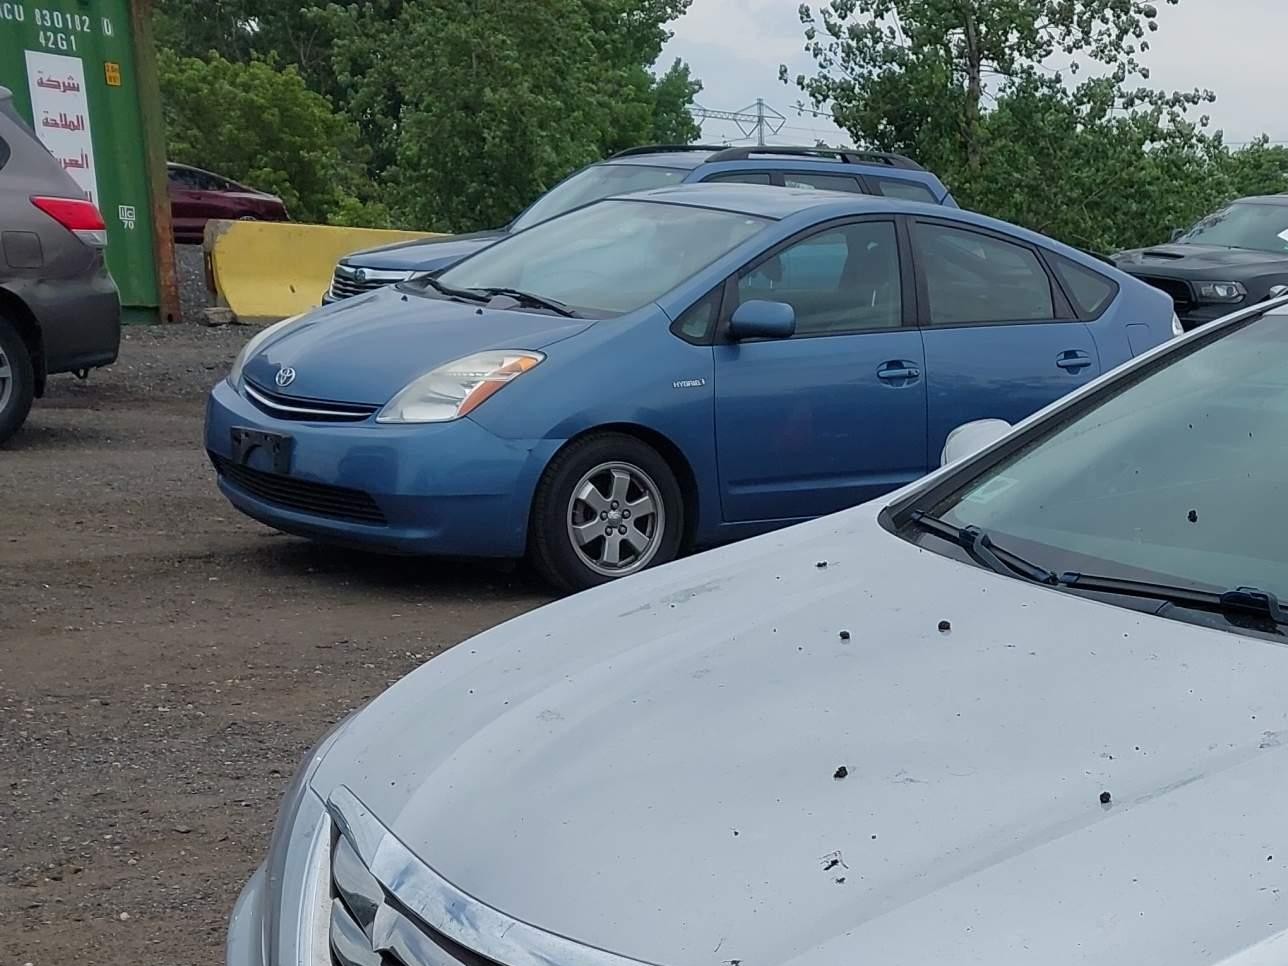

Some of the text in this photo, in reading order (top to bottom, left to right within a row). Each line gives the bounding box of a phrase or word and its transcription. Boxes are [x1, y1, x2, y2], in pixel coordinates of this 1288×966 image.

[0, 3, 24, 21] CU
[34, 8, 91, 32] 830182
[39, 30, 77, 51] 42G1
[37, 69, 80, 93] شركة
[42, 110, 85, 131] الملاحة
